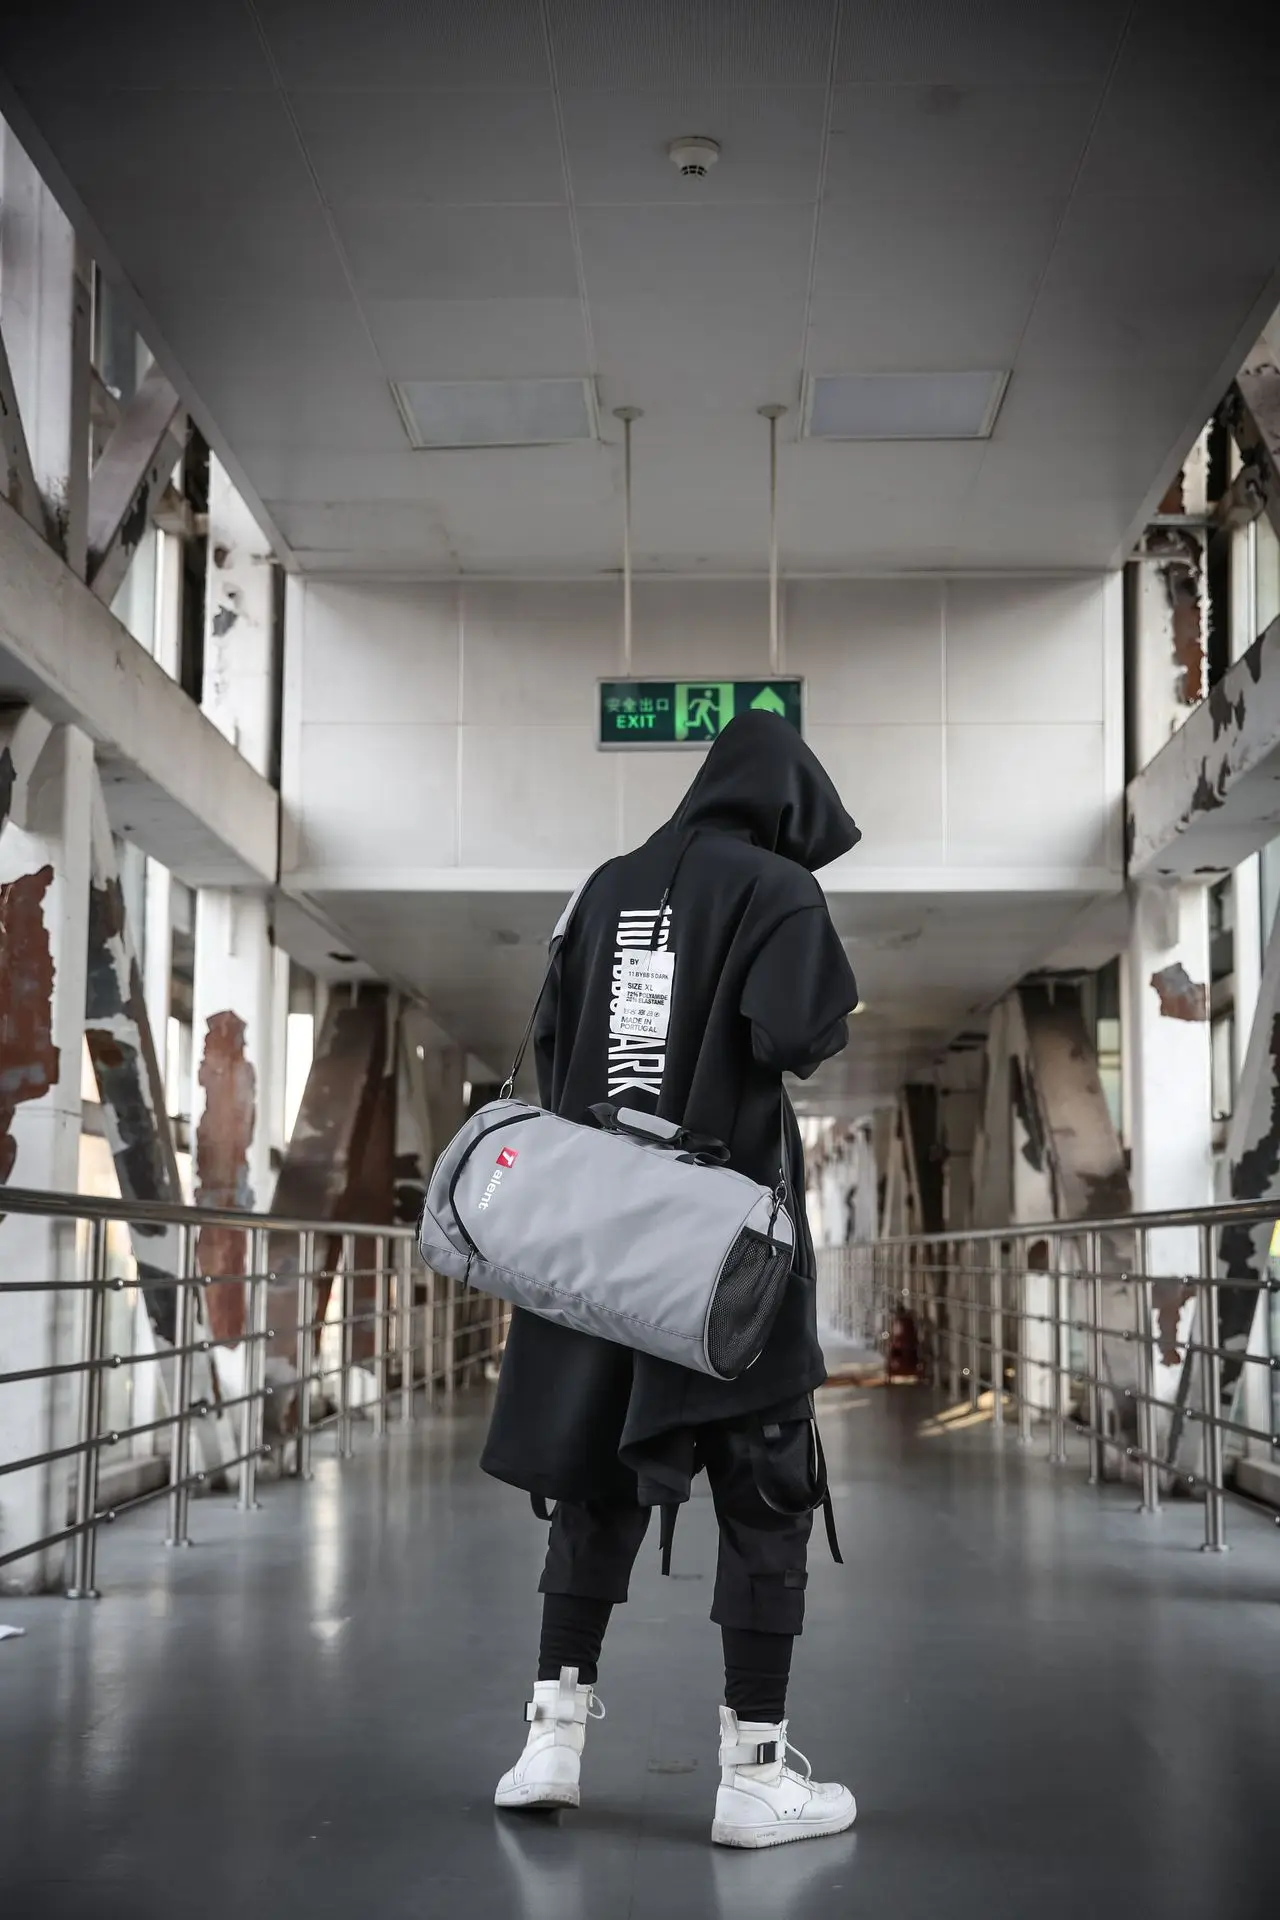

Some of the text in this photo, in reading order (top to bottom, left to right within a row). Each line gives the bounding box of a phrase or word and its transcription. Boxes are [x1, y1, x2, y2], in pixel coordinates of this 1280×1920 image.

[607, 697, 669, 713] 安全出口
[616, 714, 656, 729] EXIT
[627, 982, 654, 991] SIZE XL
[639, 992, 668, 1000] POLYAMIDE
[638, 998, 665, 1006] ELASTANE
[621, 1016, 642, 1024] MADE
[620, 1023, 658, 1033] PORTUGAL
